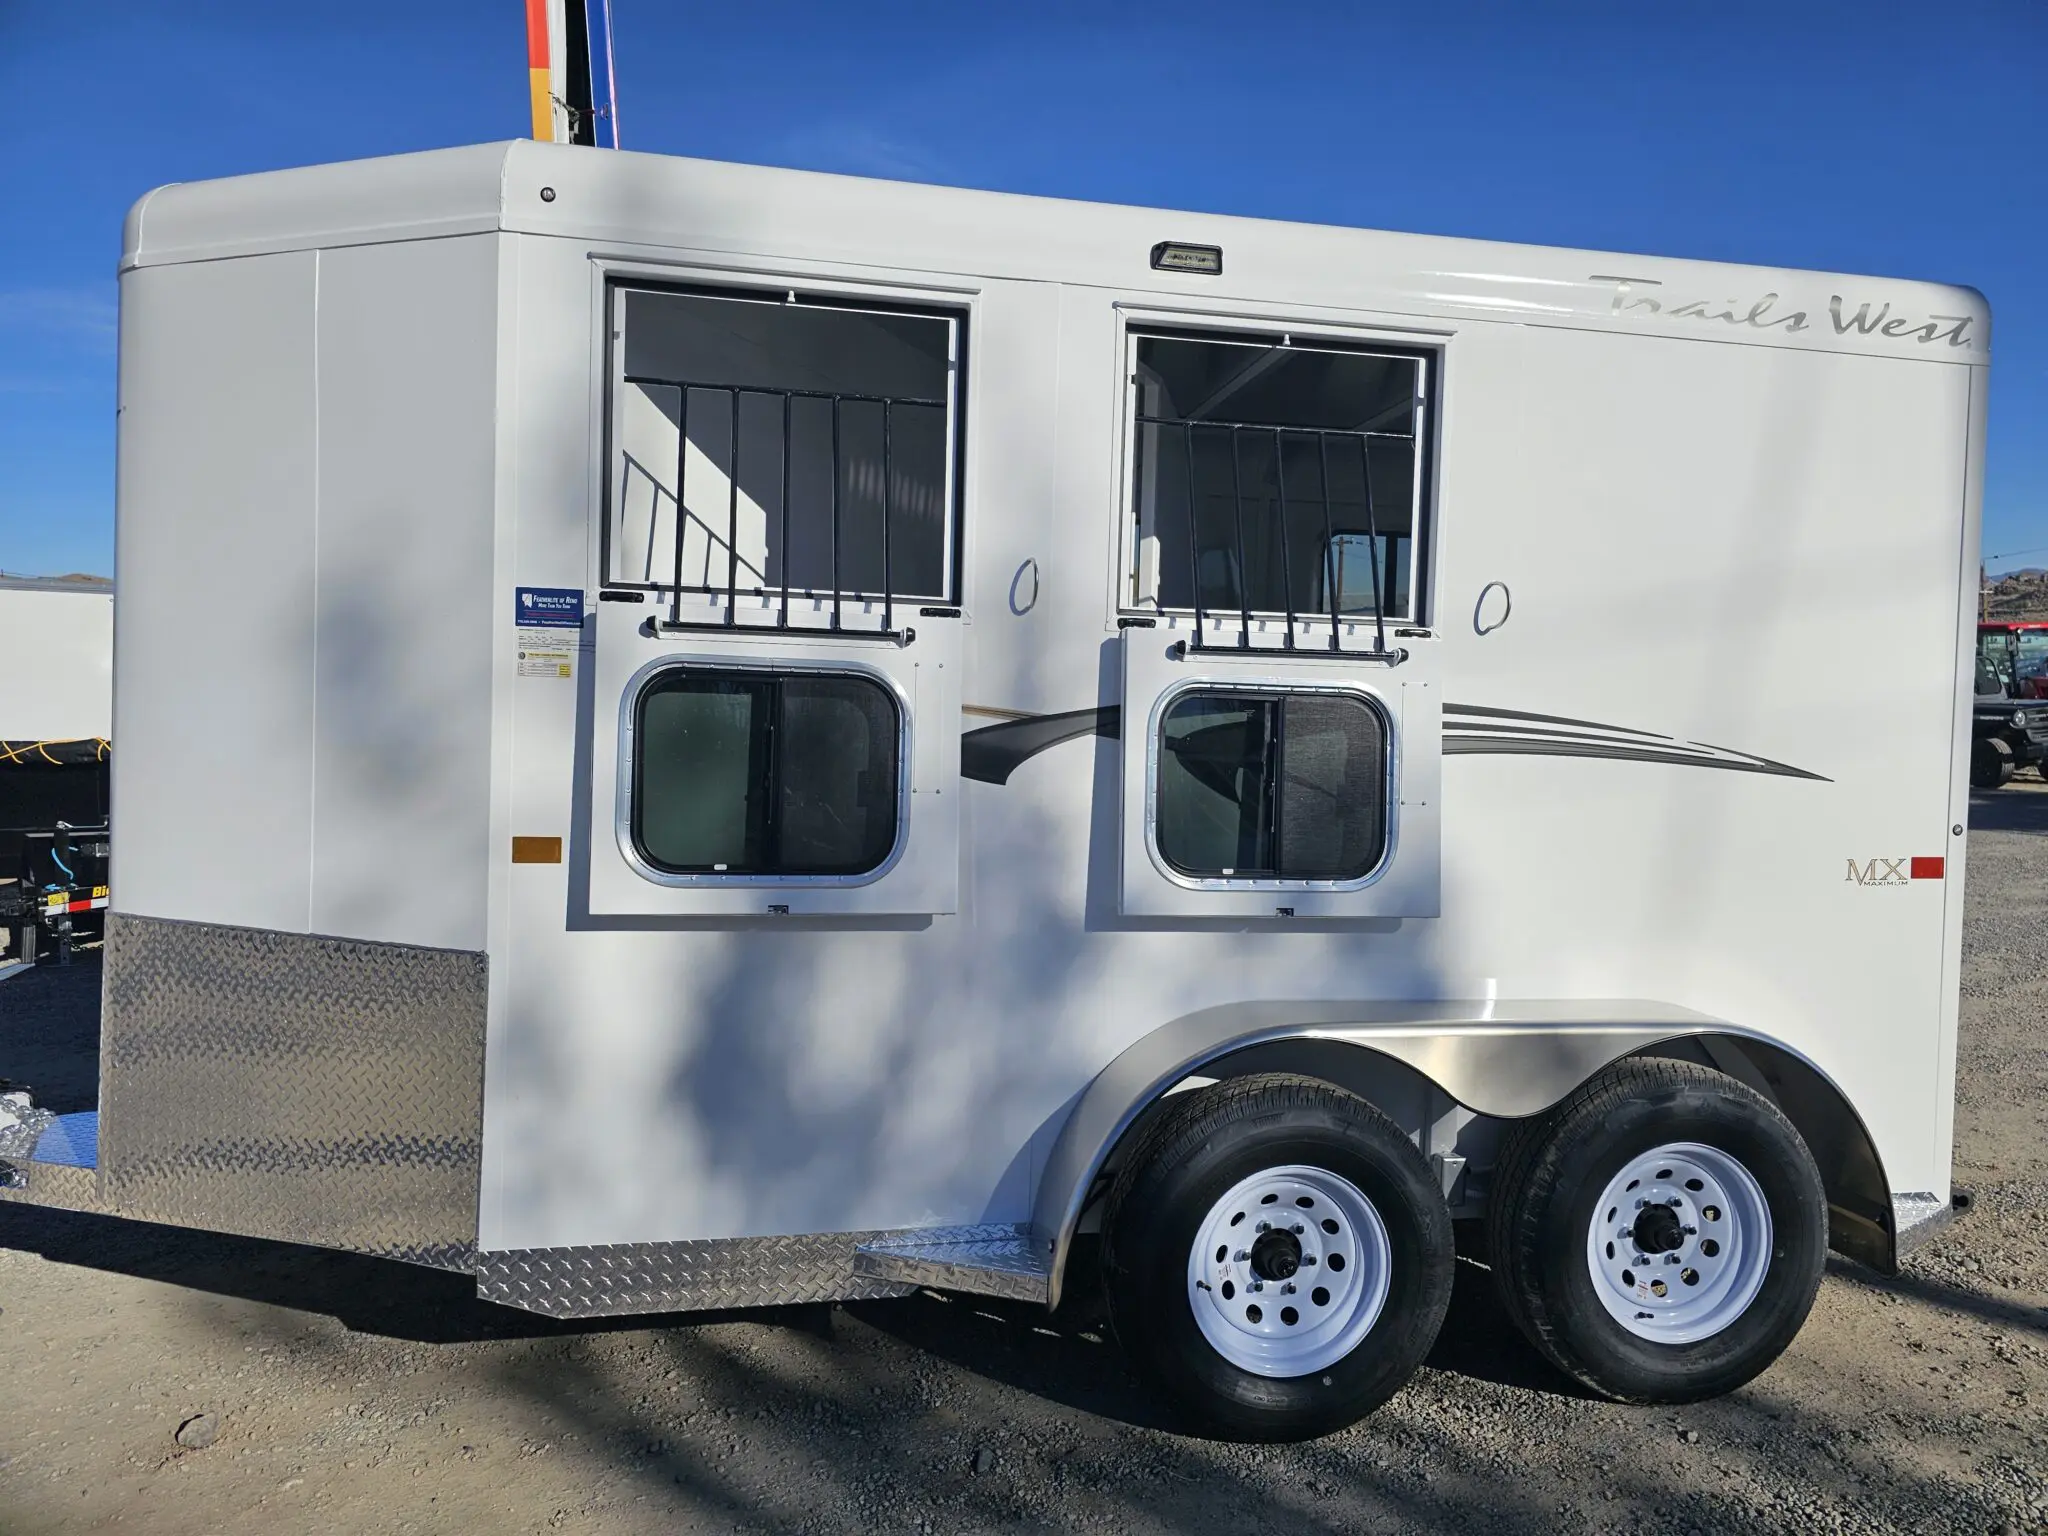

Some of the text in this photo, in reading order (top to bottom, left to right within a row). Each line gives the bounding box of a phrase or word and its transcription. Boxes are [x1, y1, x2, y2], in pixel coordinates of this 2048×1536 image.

[1589, 275, 1973, 348] Trails West
[1845, 858, 1907, 886] MX
